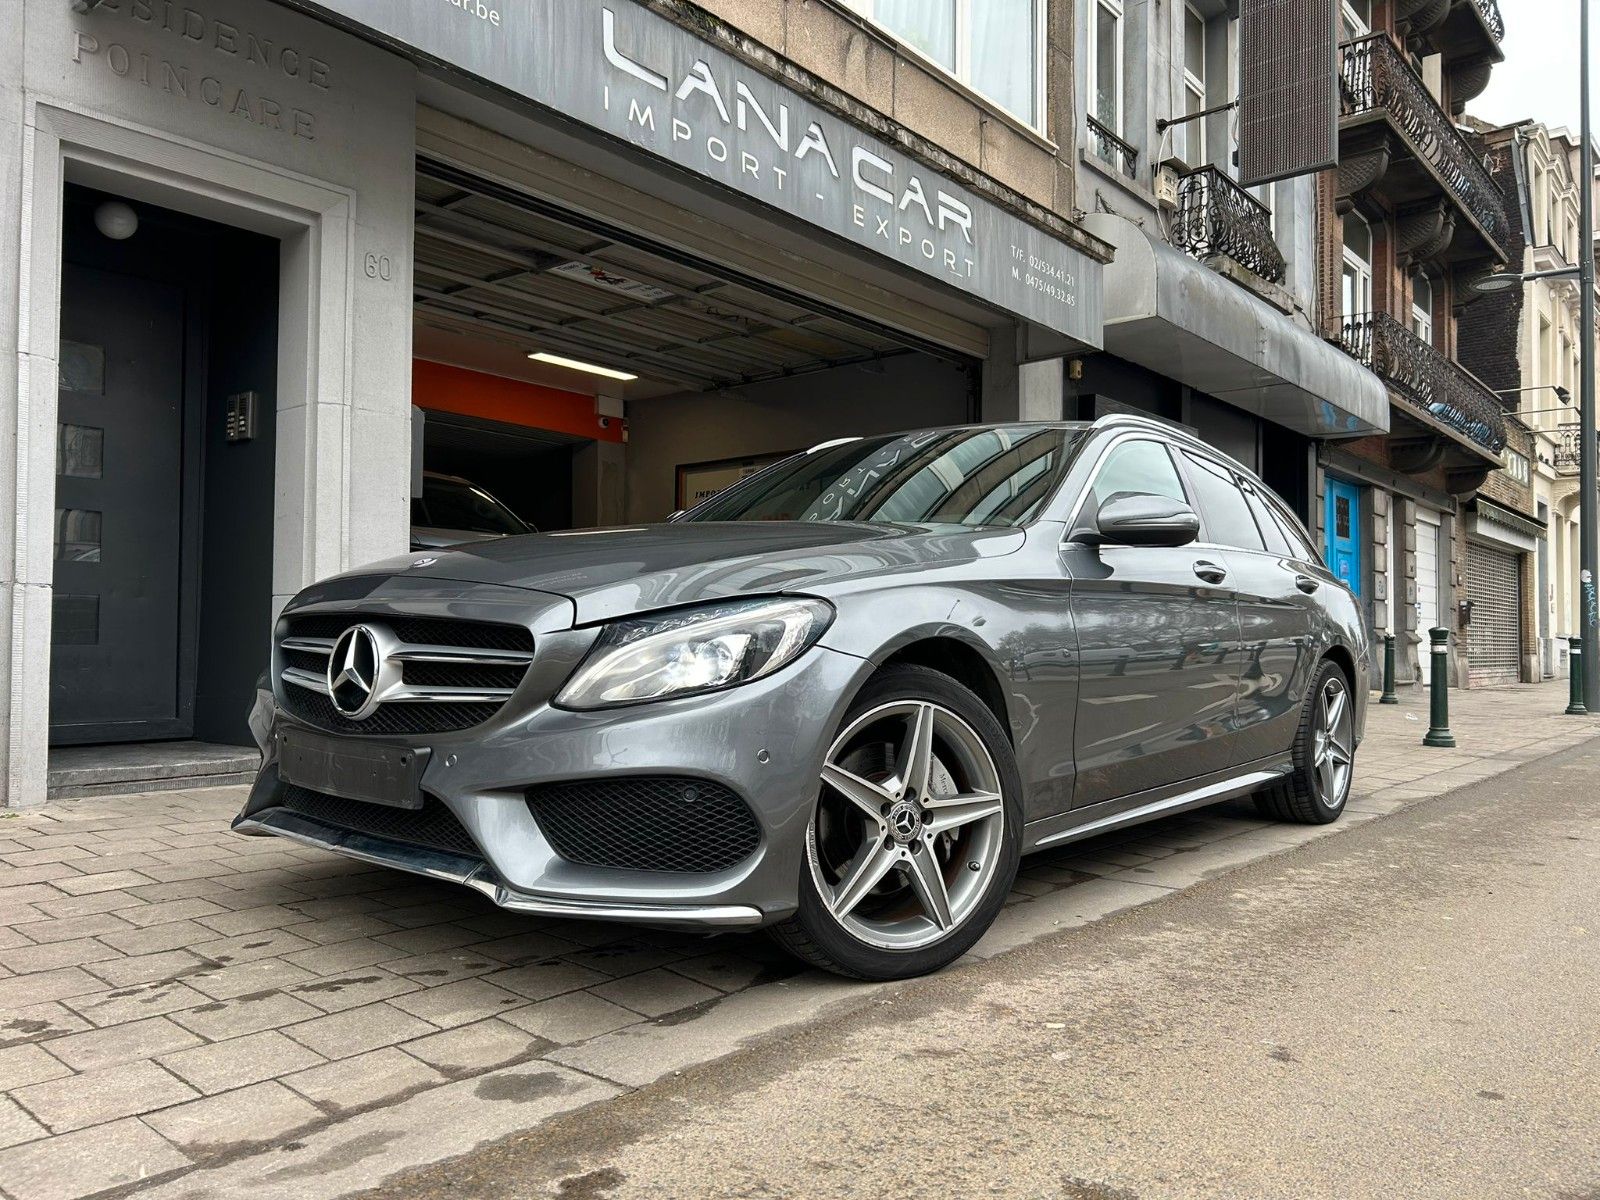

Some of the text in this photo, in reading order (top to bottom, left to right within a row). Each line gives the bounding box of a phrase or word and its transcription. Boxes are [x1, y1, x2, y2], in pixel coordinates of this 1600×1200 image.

[71, 28, 317, 141] POINCARE
[603, 85, 787, 190] IMPORT
[853, 203, 974, 278] EXPORT
[364, 252, 392, 281] 60
[1029, 255, 1075, 287] 02/534.41.21
